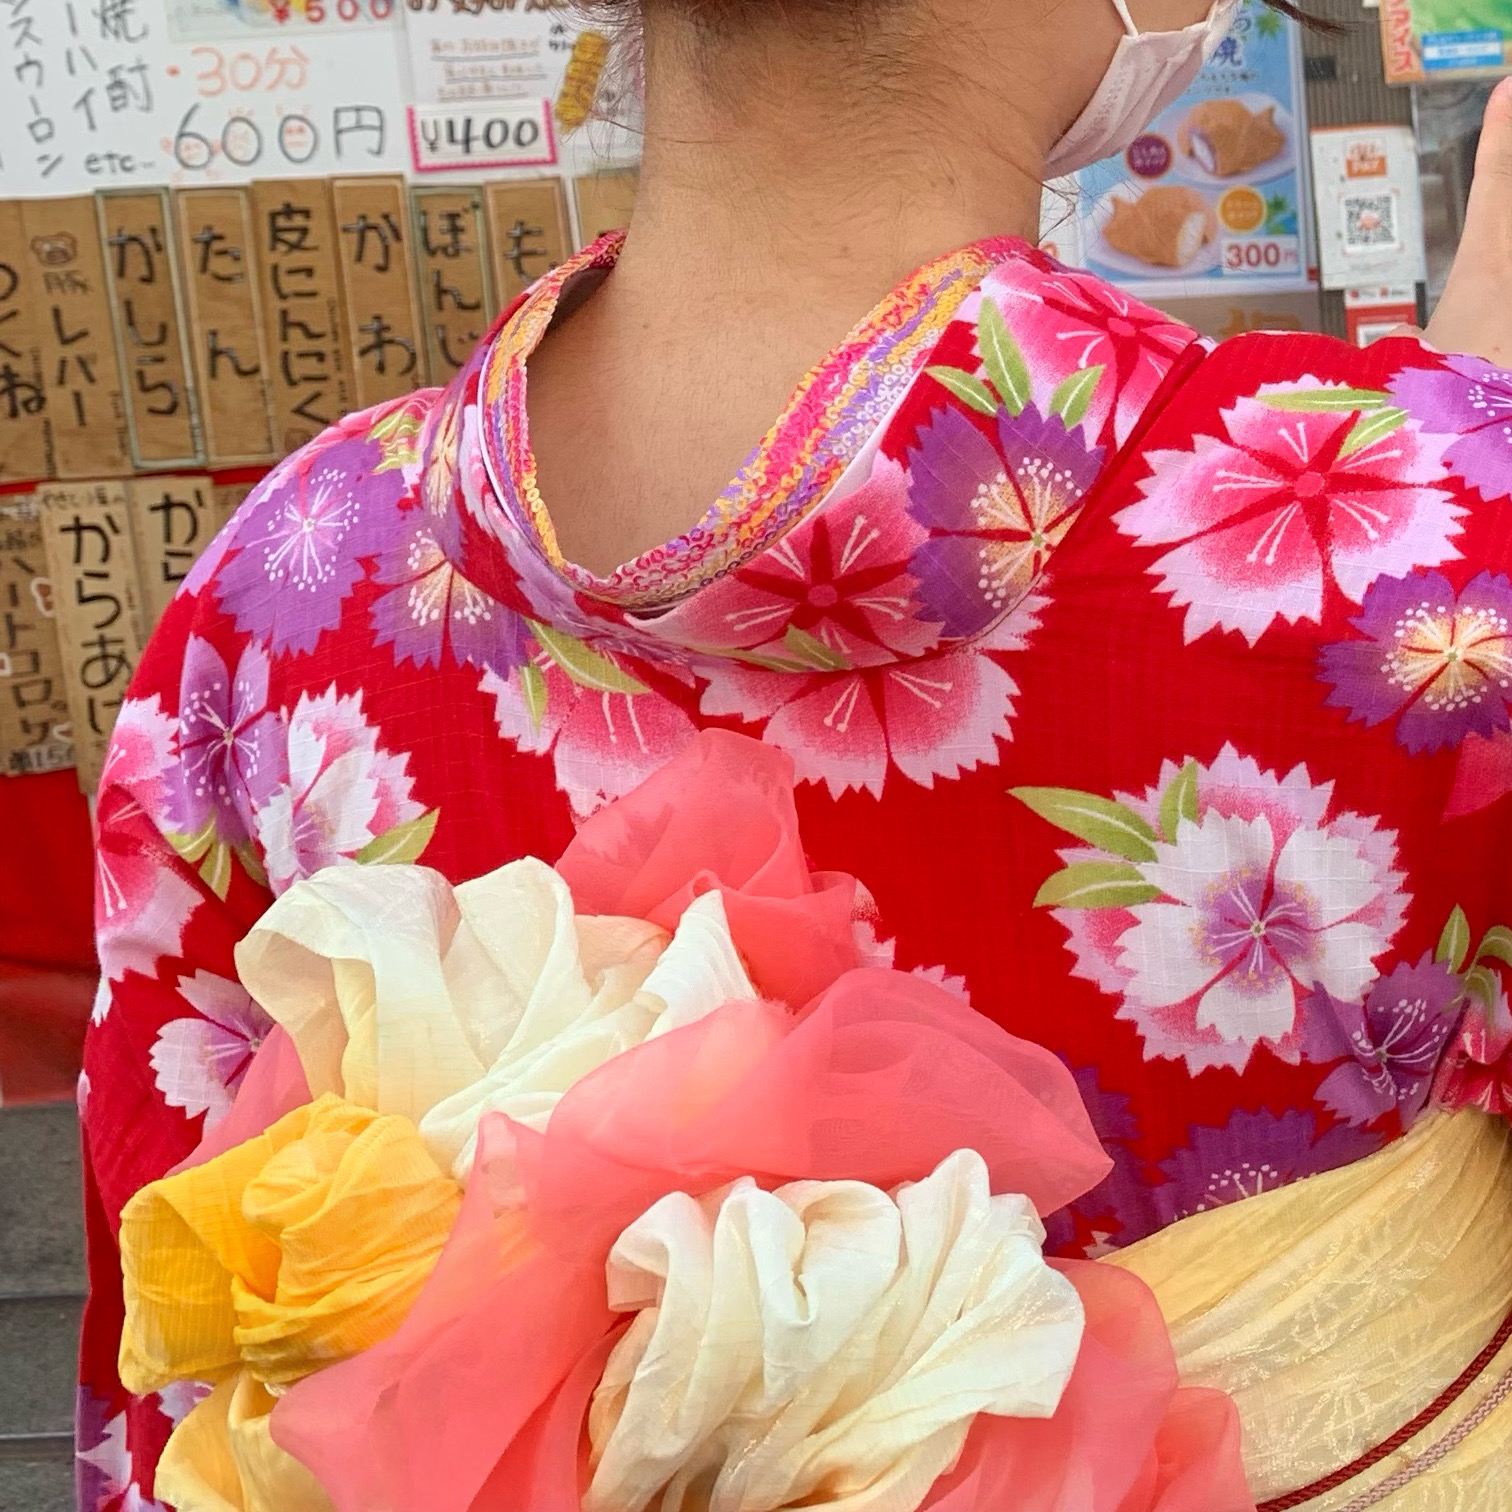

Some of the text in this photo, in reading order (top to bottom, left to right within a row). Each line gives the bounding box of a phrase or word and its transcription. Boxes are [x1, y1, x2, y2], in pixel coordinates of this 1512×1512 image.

[174, 101, 385, 171] 600円
[194, 46, 310, 99] 30分
[420, 115, 541, 156] ¥400
[106, 225, 181, 416] かしら
[191, 225, 261, 379] たん
[268, 201, 331, 426] 皮にんにく
[342, 212, 418, 377] かわ
